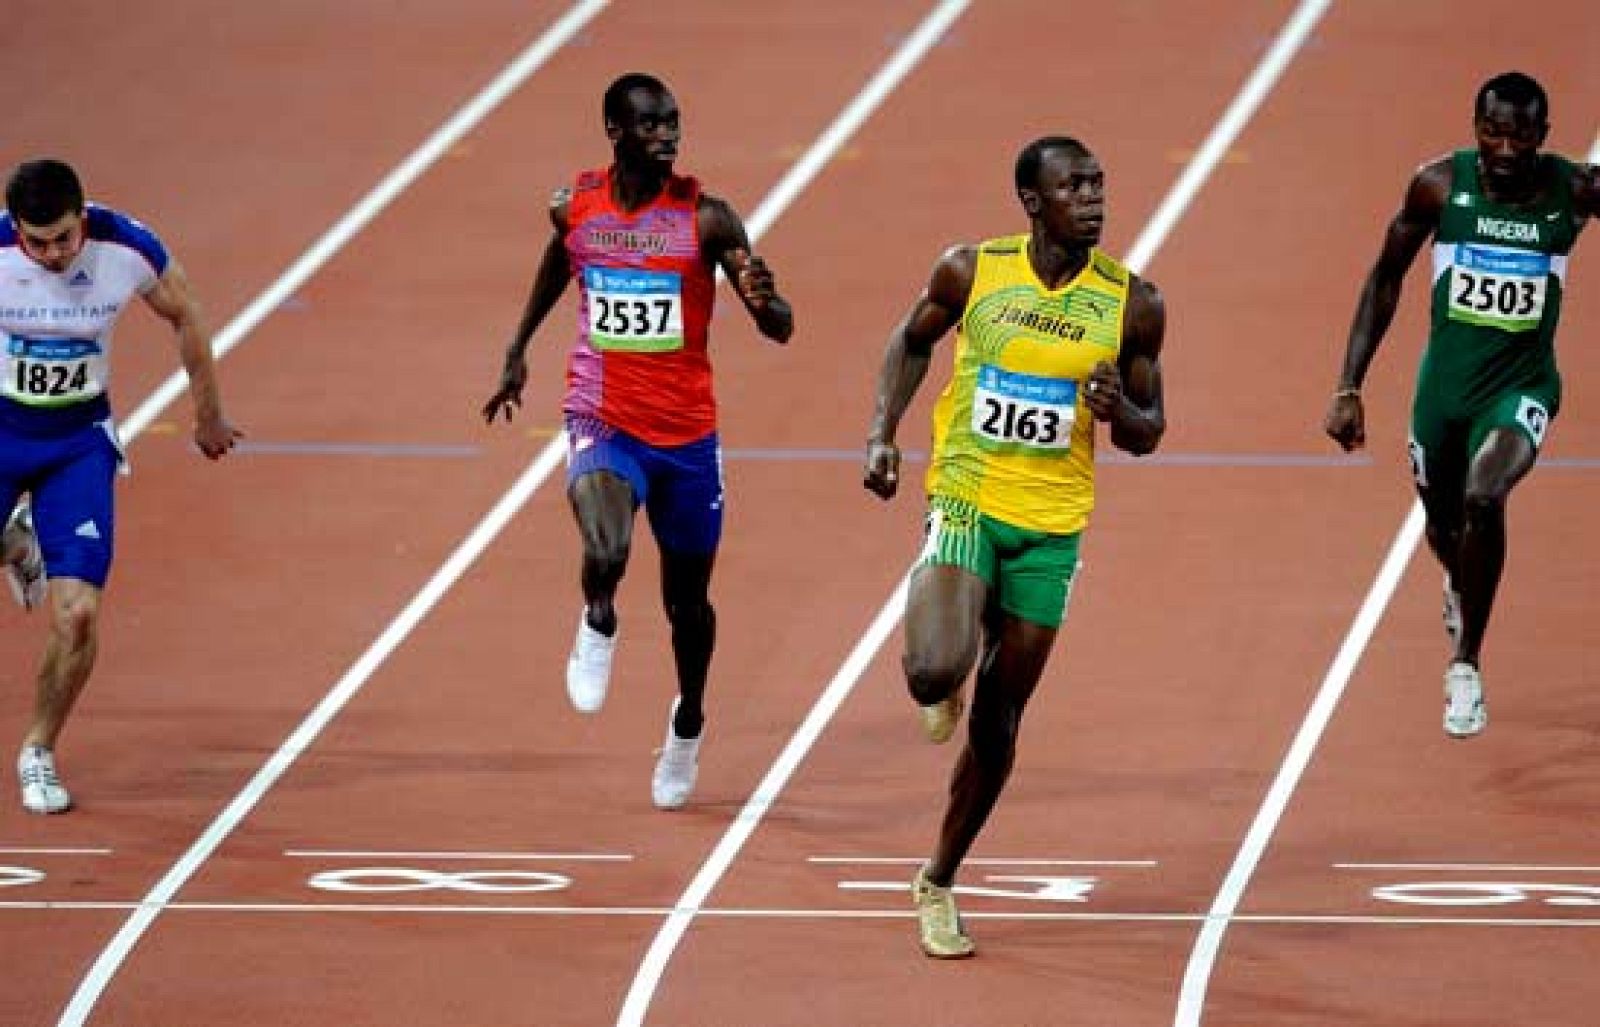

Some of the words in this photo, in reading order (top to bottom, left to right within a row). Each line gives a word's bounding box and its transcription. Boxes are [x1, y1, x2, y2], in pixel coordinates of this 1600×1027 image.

[1476, 214, 1540, 243] NIGERIA
[1456, 272, 1537, 315] 2503
[595, 296, 673, 335] 2537
[16, 360, 88, 396] 1824
[980, 398, 1060, 443] 2163
[306, 867, 573, 892] 8
